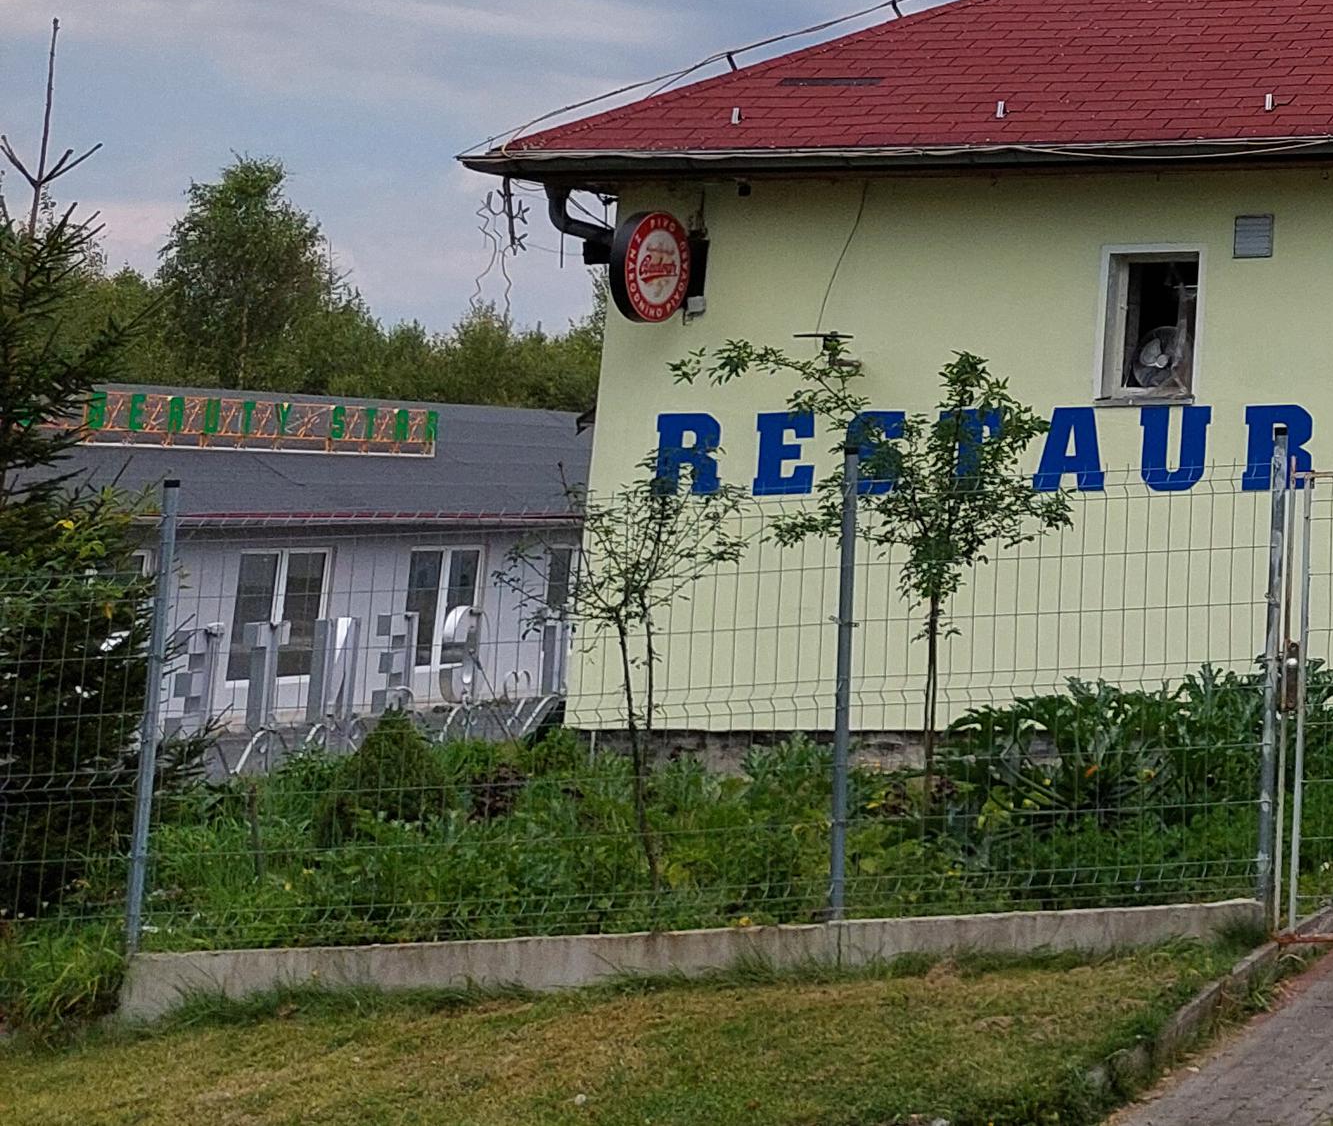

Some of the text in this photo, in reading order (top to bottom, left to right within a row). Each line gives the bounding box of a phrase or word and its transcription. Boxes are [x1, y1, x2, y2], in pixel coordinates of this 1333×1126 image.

[650, 217, 677, 233] PIVO
[87, 392, 439, 443] BEAUTY STAR
